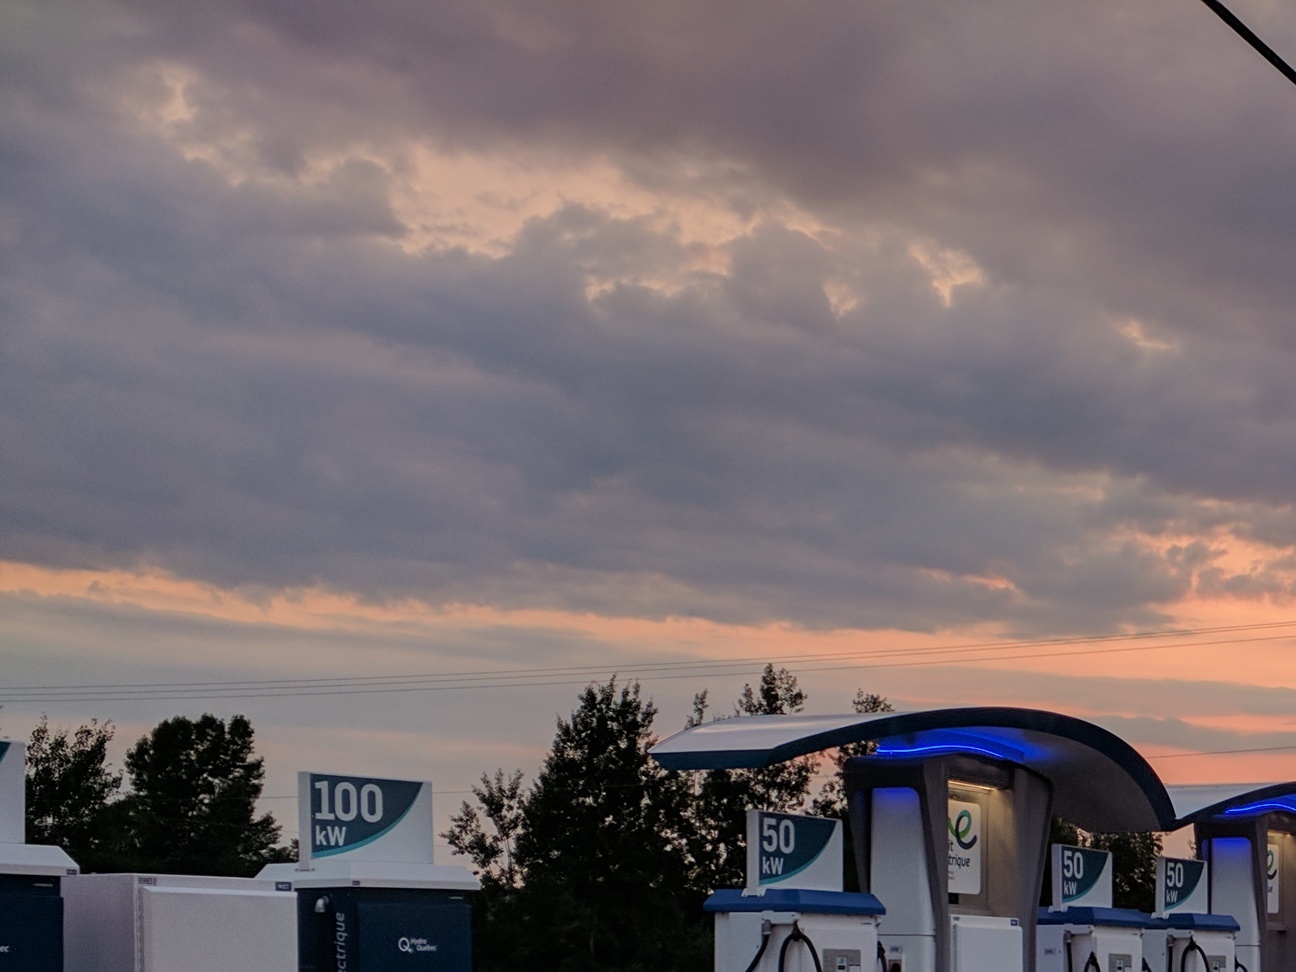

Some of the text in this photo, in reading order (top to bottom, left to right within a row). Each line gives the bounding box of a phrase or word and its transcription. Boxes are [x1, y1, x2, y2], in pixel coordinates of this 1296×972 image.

[314, 780, 383, 823] 100
[315, 825, 347, 847] kW
[762, 817, 795, 854] 50
[762, 856, 784, 875] kW
[1063, 850, 1084, 879] 50
[1166, 862, 1184, 888] 50
[1063, 880, 1077, 895] kW
[1166, 889, 1178, 903] kW
